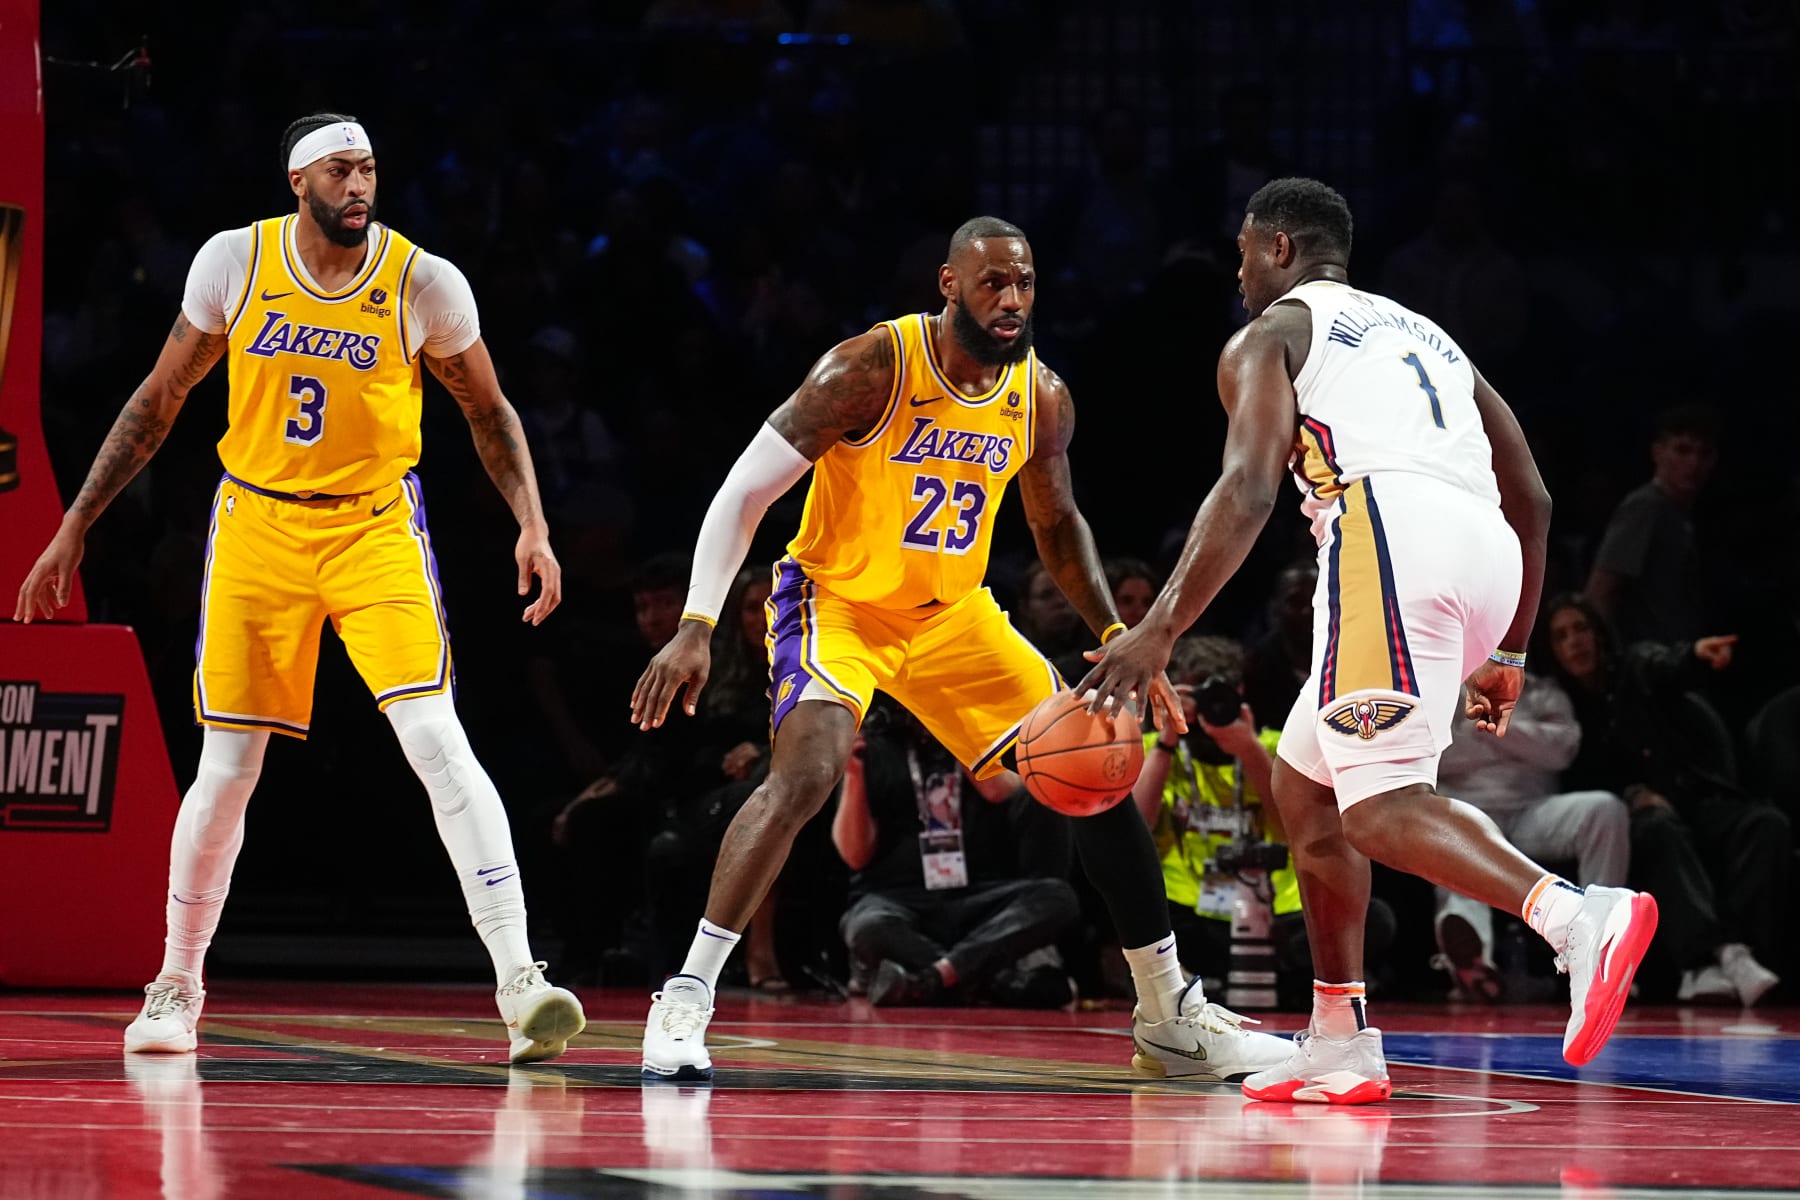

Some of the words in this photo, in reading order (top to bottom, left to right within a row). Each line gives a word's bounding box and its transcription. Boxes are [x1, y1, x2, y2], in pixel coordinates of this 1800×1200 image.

[360, 303, 391, 318] bibigo
[1328, 308, 1461, 365] WILLIAMSON
[245, 311, 383, 371] LAKERS
[285, 375, 327, 446] 3
[1001, 408, 1023, 421] bibigo
[1400, 349, 1448, 430] 1
[889, 416, 1013, 473] LAKERS
[901, 474, 987, 555] 23
[0, 684, 36, 724] ON
[0, 714, 119, 815] MENT
